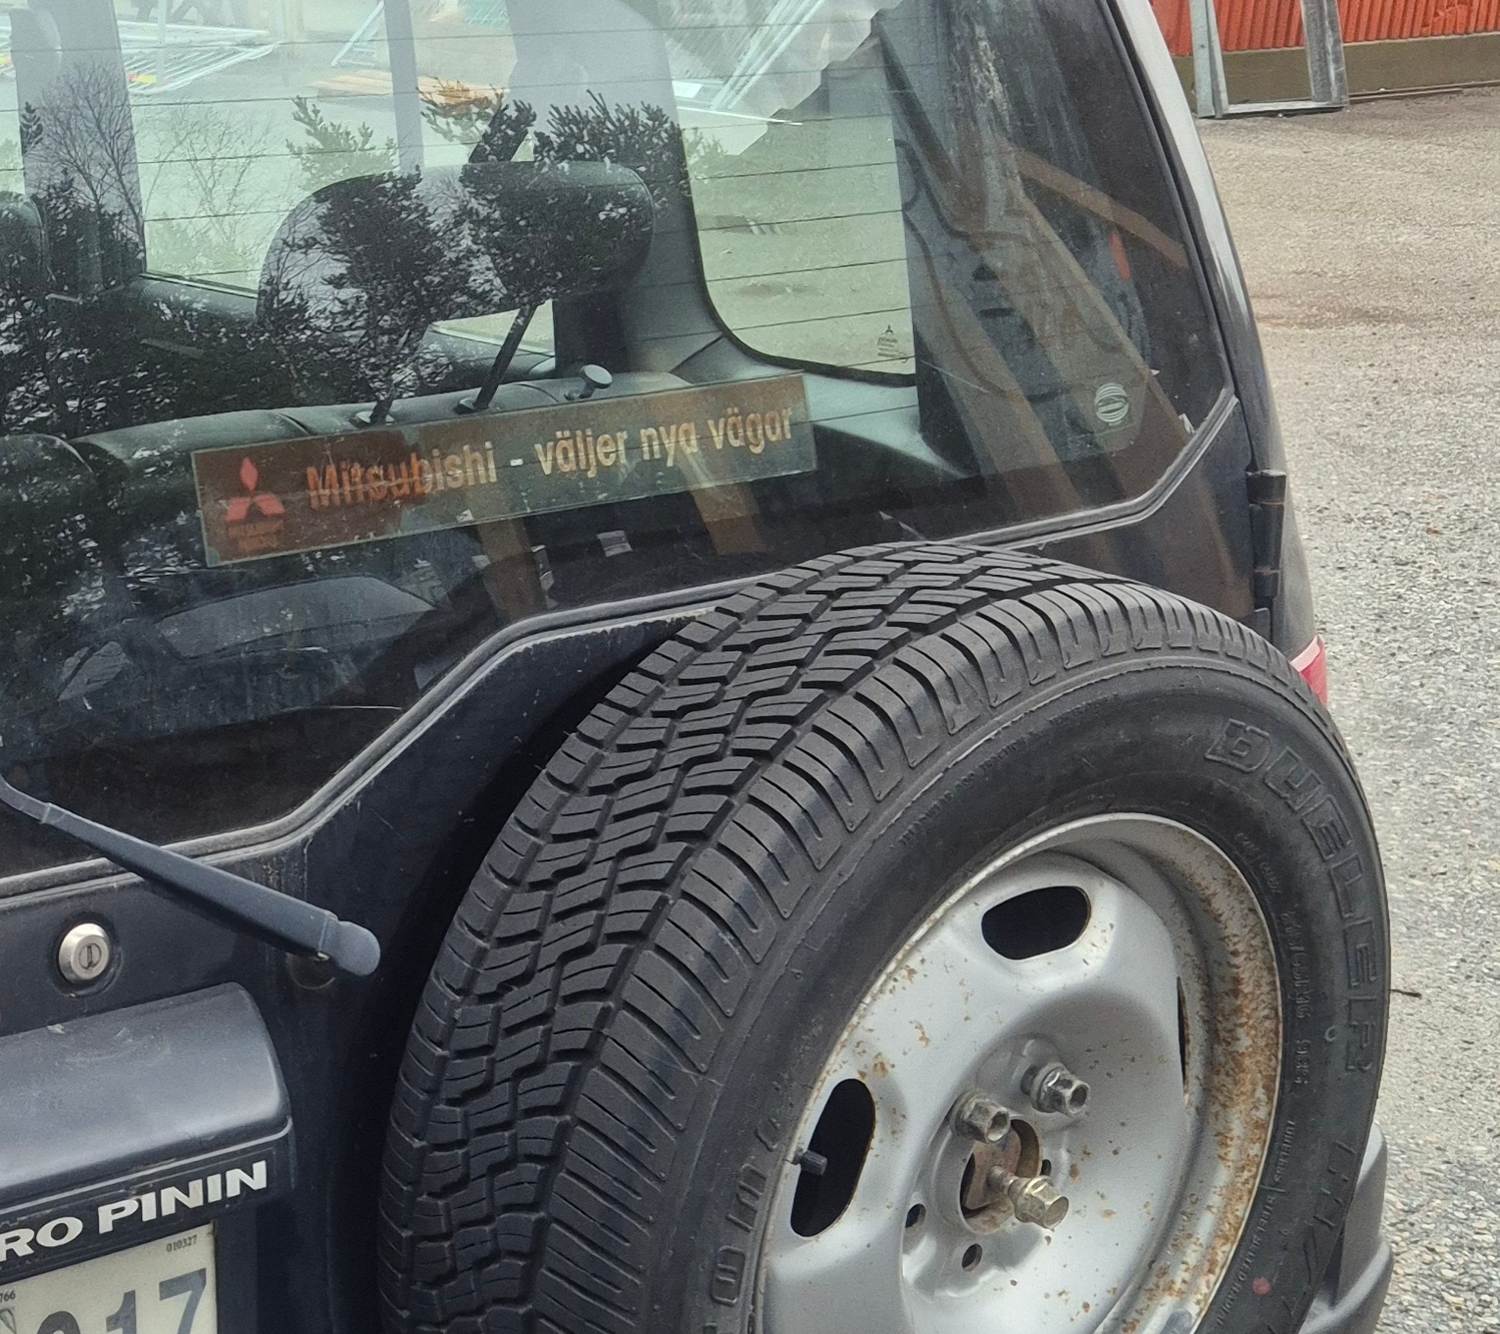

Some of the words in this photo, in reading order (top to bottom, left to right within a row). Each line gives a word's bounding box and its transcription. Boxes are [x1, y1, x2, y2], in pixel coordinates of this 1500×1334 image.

[306, 441, 498, 510] Mitsubishi
[534, 427, 628, 478] väljer
[639, 421, 699, 467] nya
[707, 407, 792, 455] vägar
[98, 1160, 267, 1234] PININ
[165, 1233, 198, 1253] 010327
